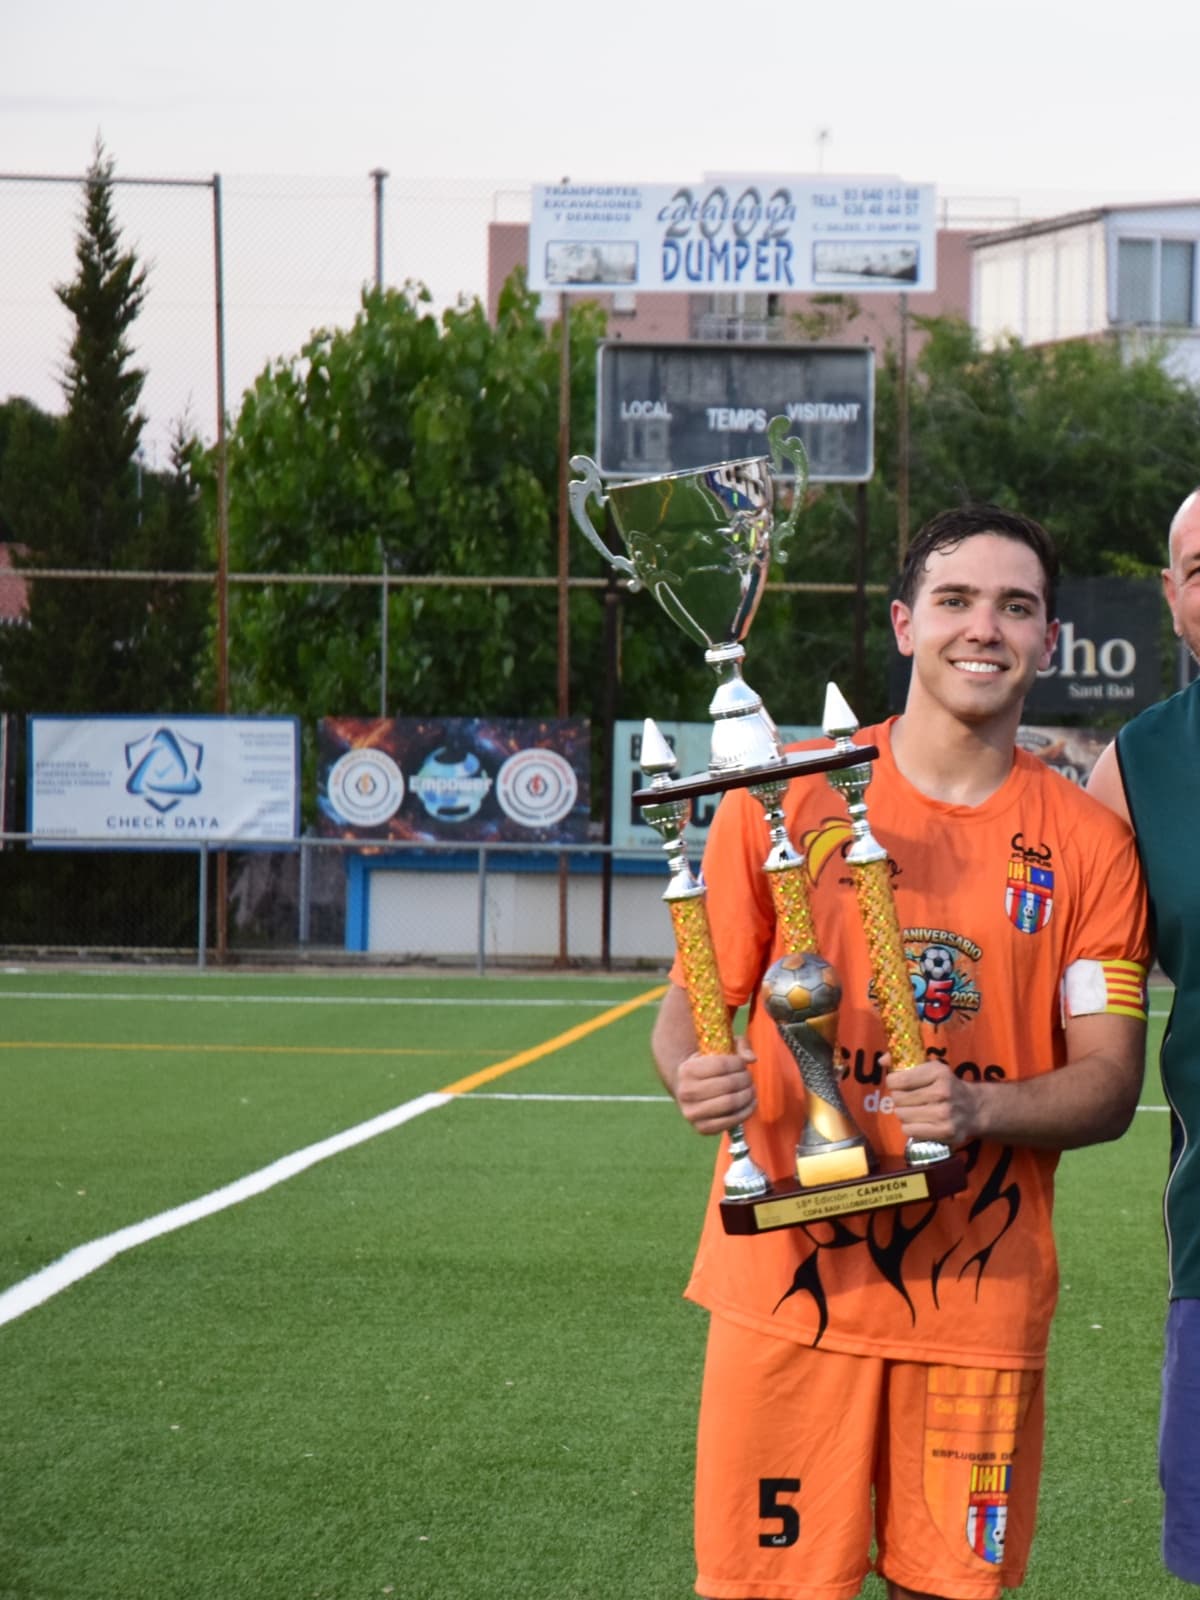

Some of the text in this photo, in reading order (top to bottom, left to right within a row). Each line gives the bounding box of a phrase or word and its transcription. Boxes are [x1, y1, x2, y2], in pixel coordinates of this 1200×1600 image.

[664, 186, 793, 239] 2002
[662, 239, 795, 286] DUMPER
[620, 401, 861, 432] LOCAL TEMPS VISITANT
[1068, 683, 1135, 698] Sant Boi
[106, 816, 220, 830] CHECK DATA
[903, 928, 982, 961] ANIVERSARIO
[950, 991, 980, 1008] 2025
[857, 1180, 908, 1198] CAMPEÓN
[759, 1478, 801, 1548] 5
